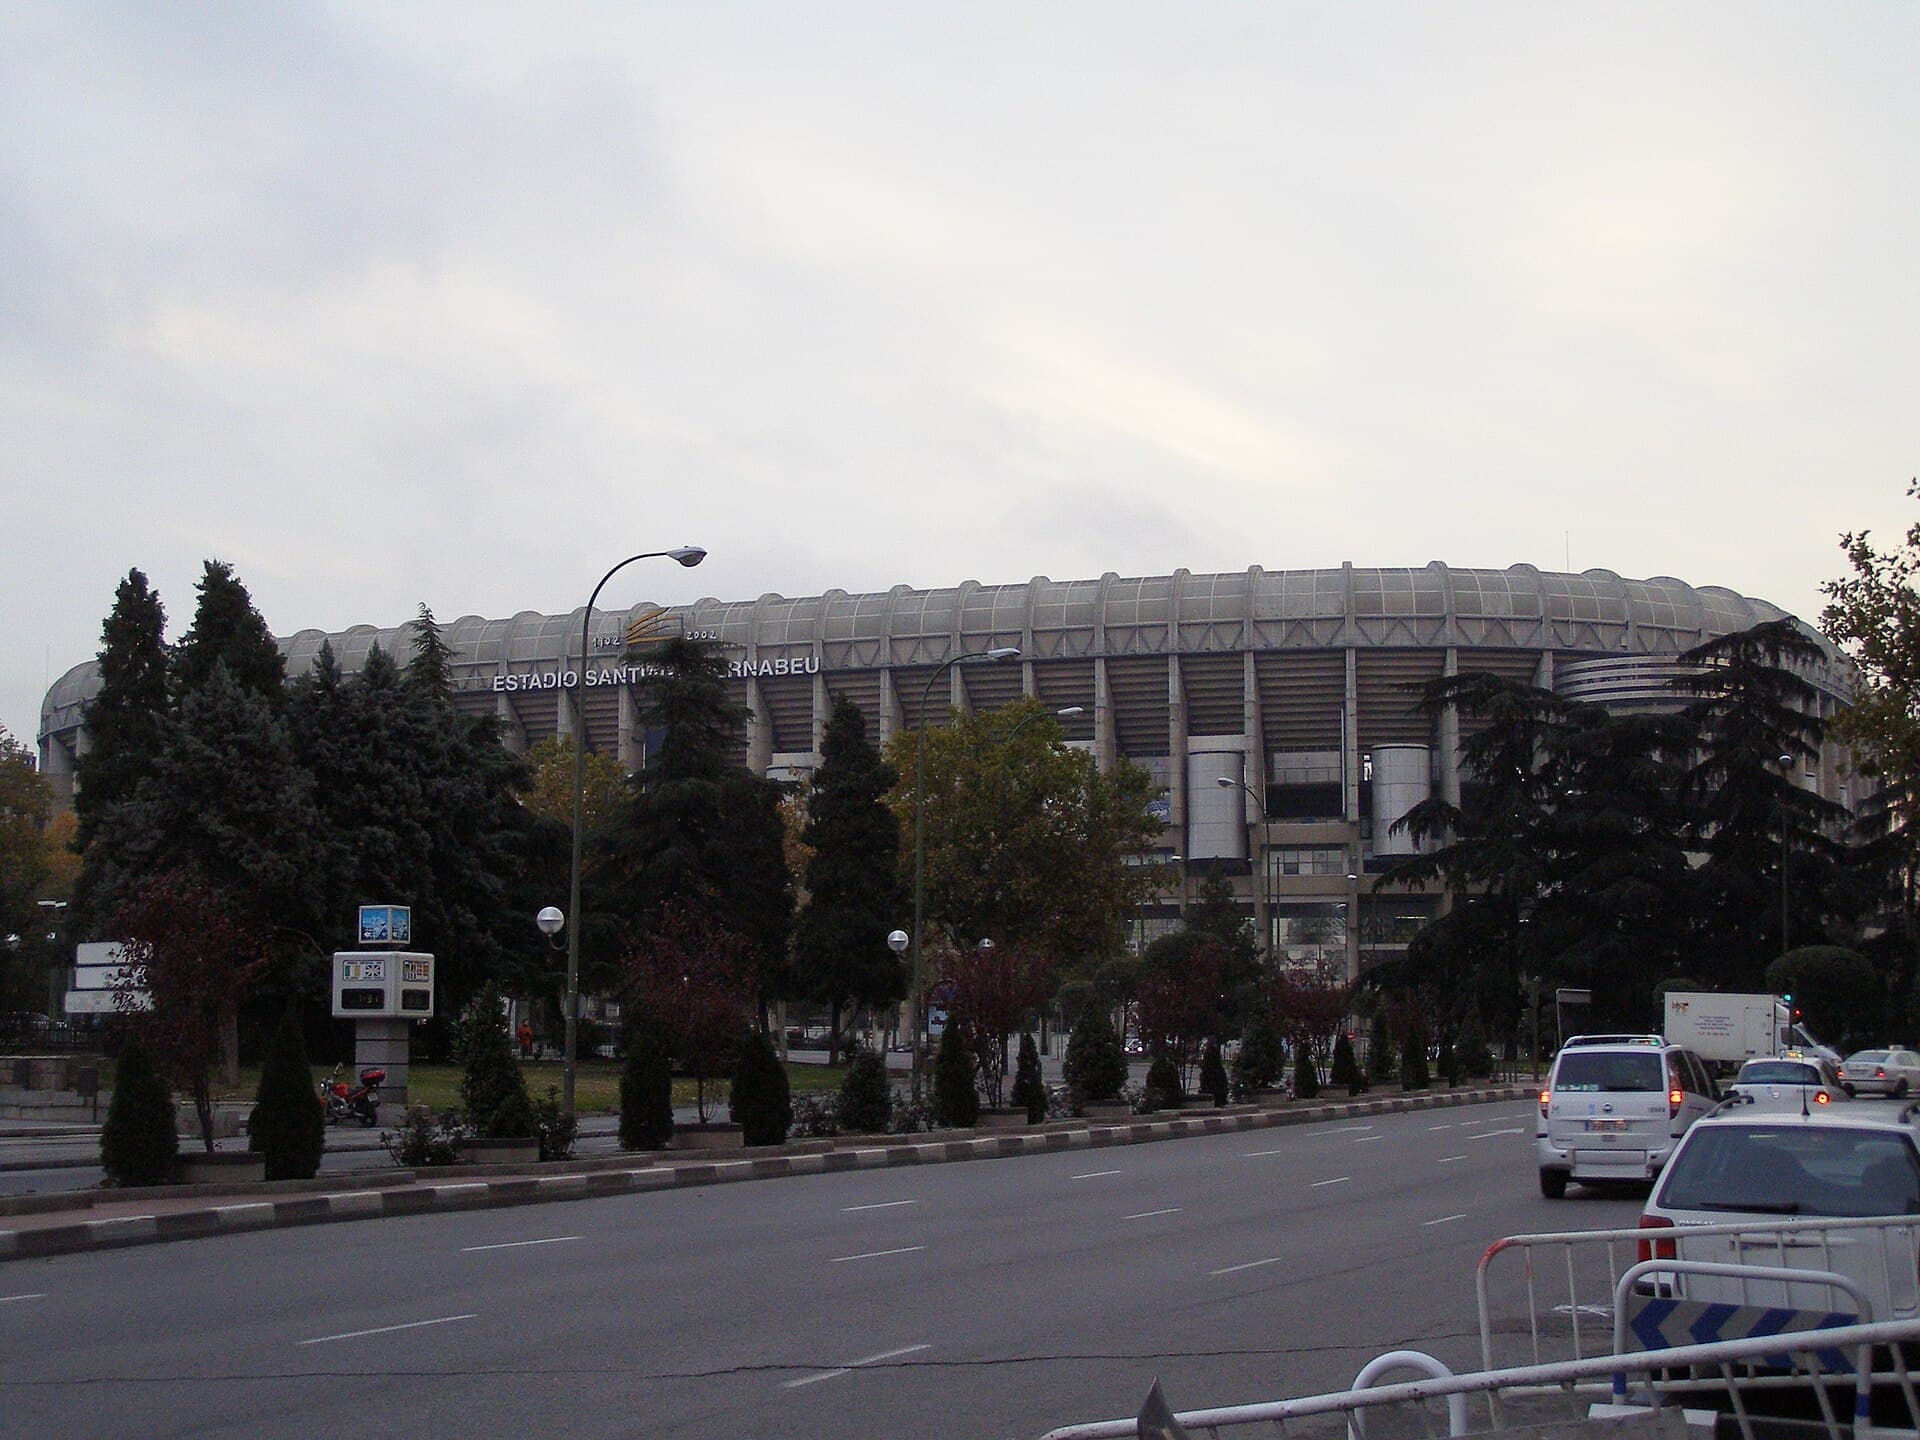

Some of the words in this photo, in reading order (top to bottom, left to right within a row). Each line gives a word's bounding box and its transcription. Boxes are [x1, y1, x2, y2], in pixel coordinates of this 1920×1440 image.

[686, 630, 717, 641] 2002
[492, 670, 578, 692] ESTADIO
[704, 656, 820, 679] RNABEU
